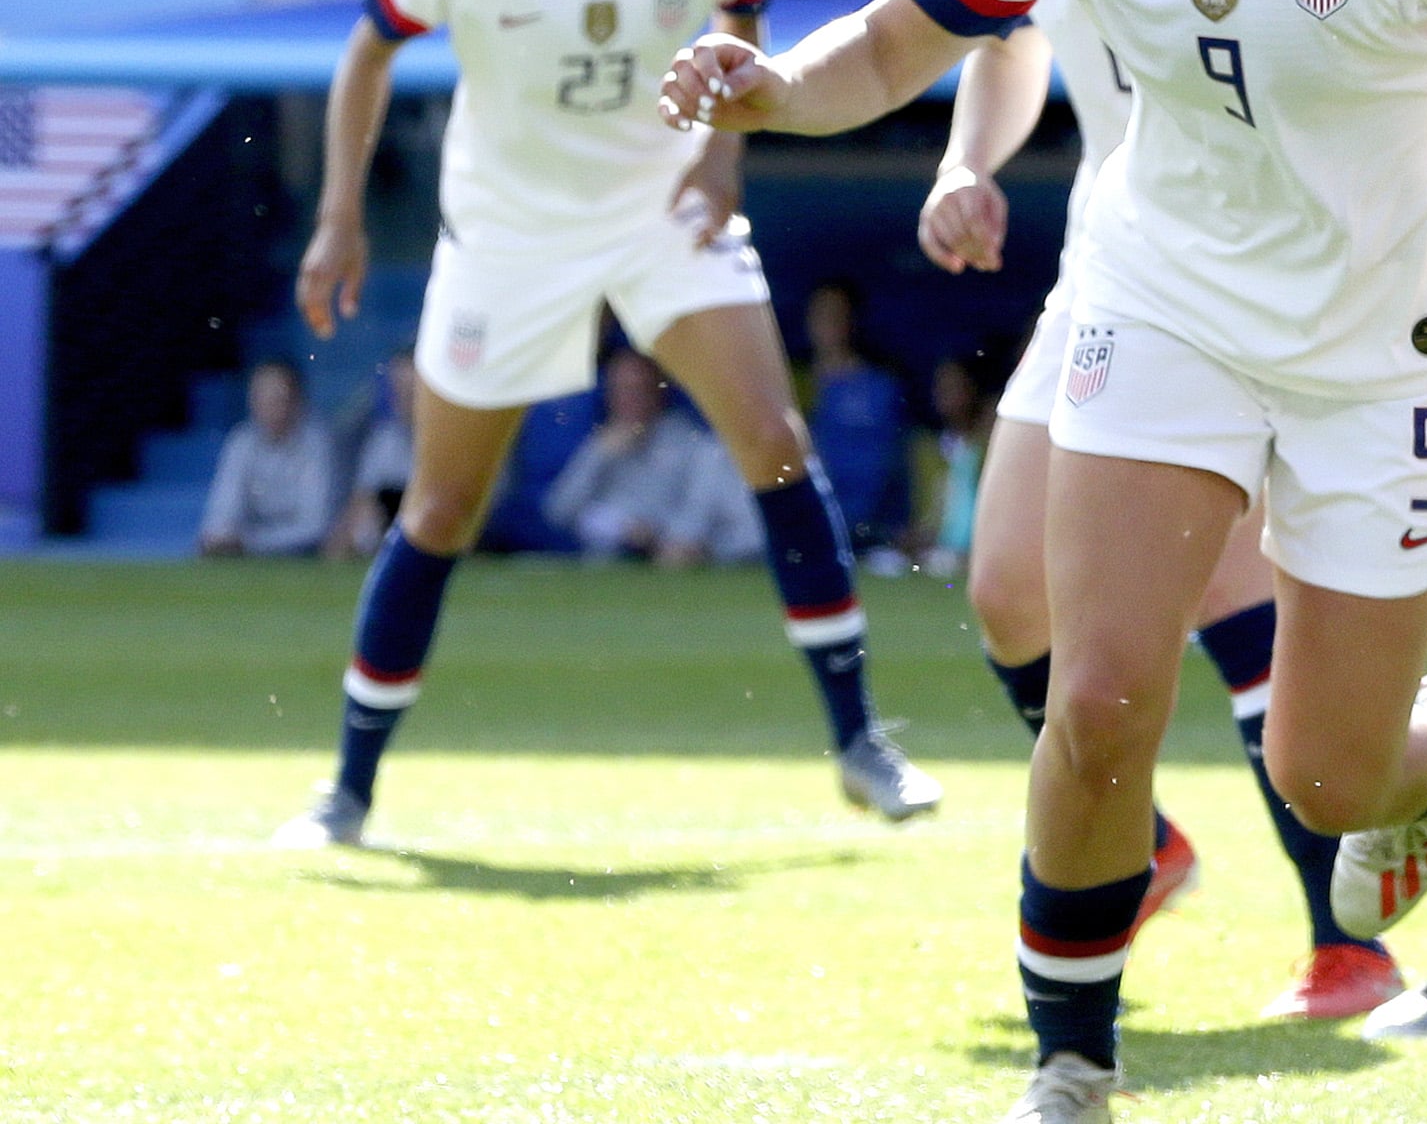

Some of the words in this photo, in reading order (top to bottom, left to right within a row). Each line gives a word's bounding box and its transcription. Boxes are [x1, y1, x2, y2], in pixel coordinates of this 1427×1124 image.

[557, 50, 637, 116] 23
[1197, 36, 1256, 129] 9
[1075, 347, 1108, 370] USA
